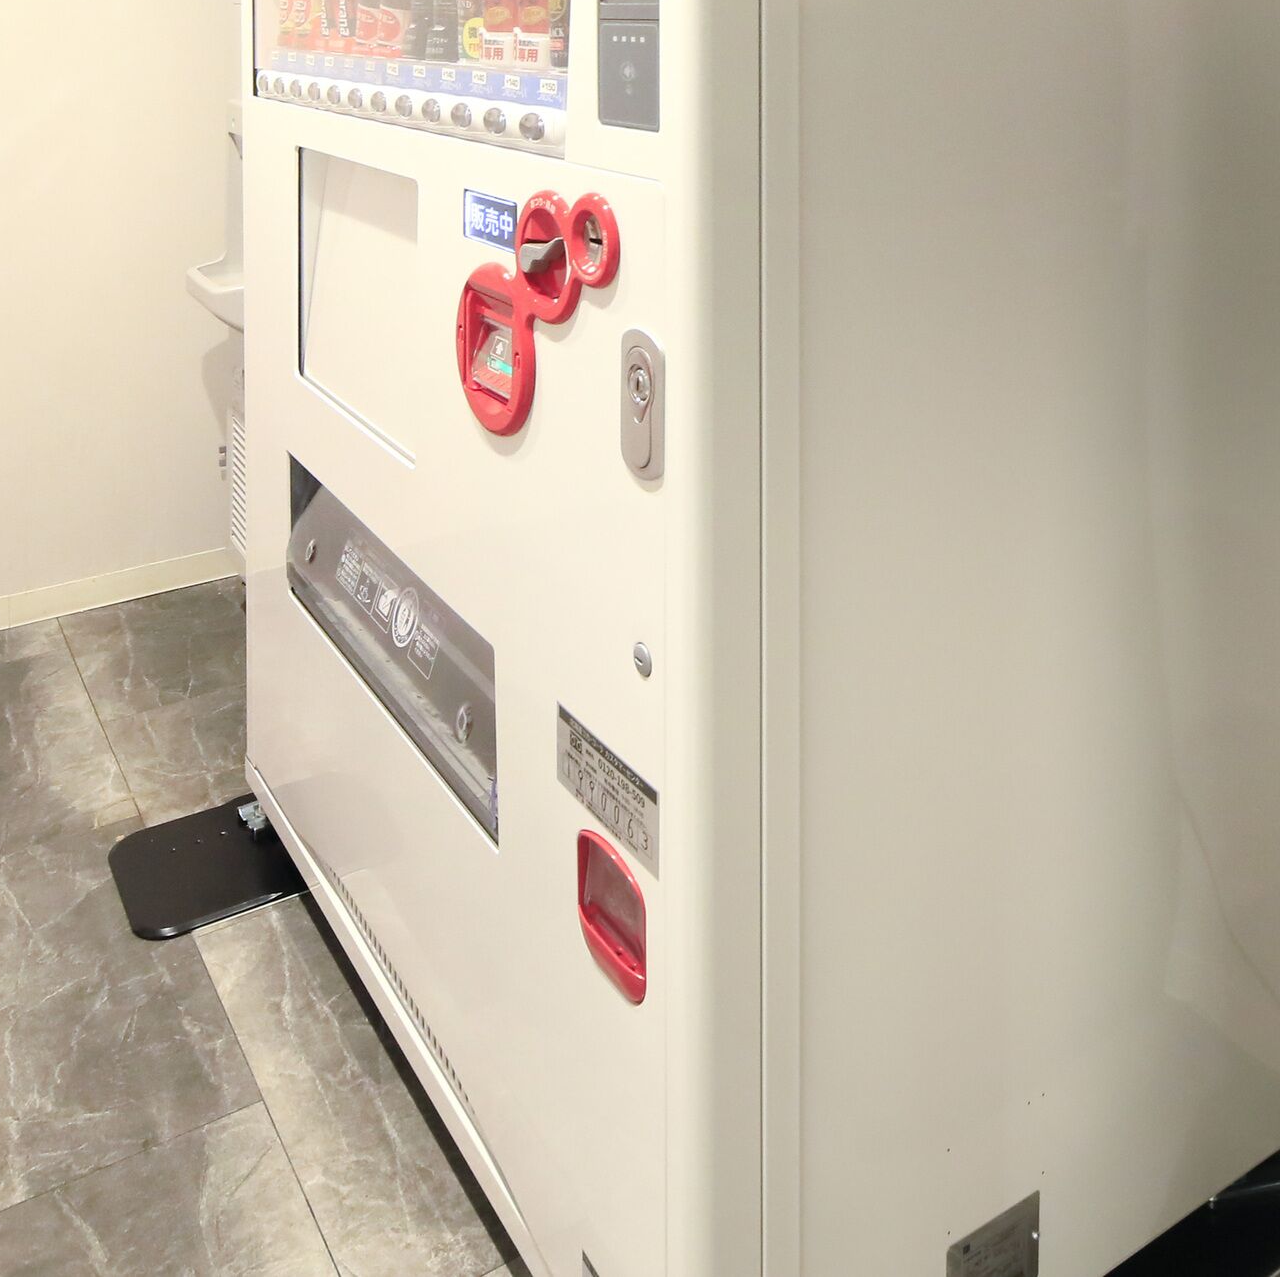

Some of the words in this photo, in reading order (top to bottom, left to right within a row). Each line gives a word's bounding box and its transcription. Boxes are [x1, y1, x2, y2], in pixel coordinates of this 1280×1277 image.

[541, 82, 556, 92] ¥150
[470, 202, 514, 240] 販売中
